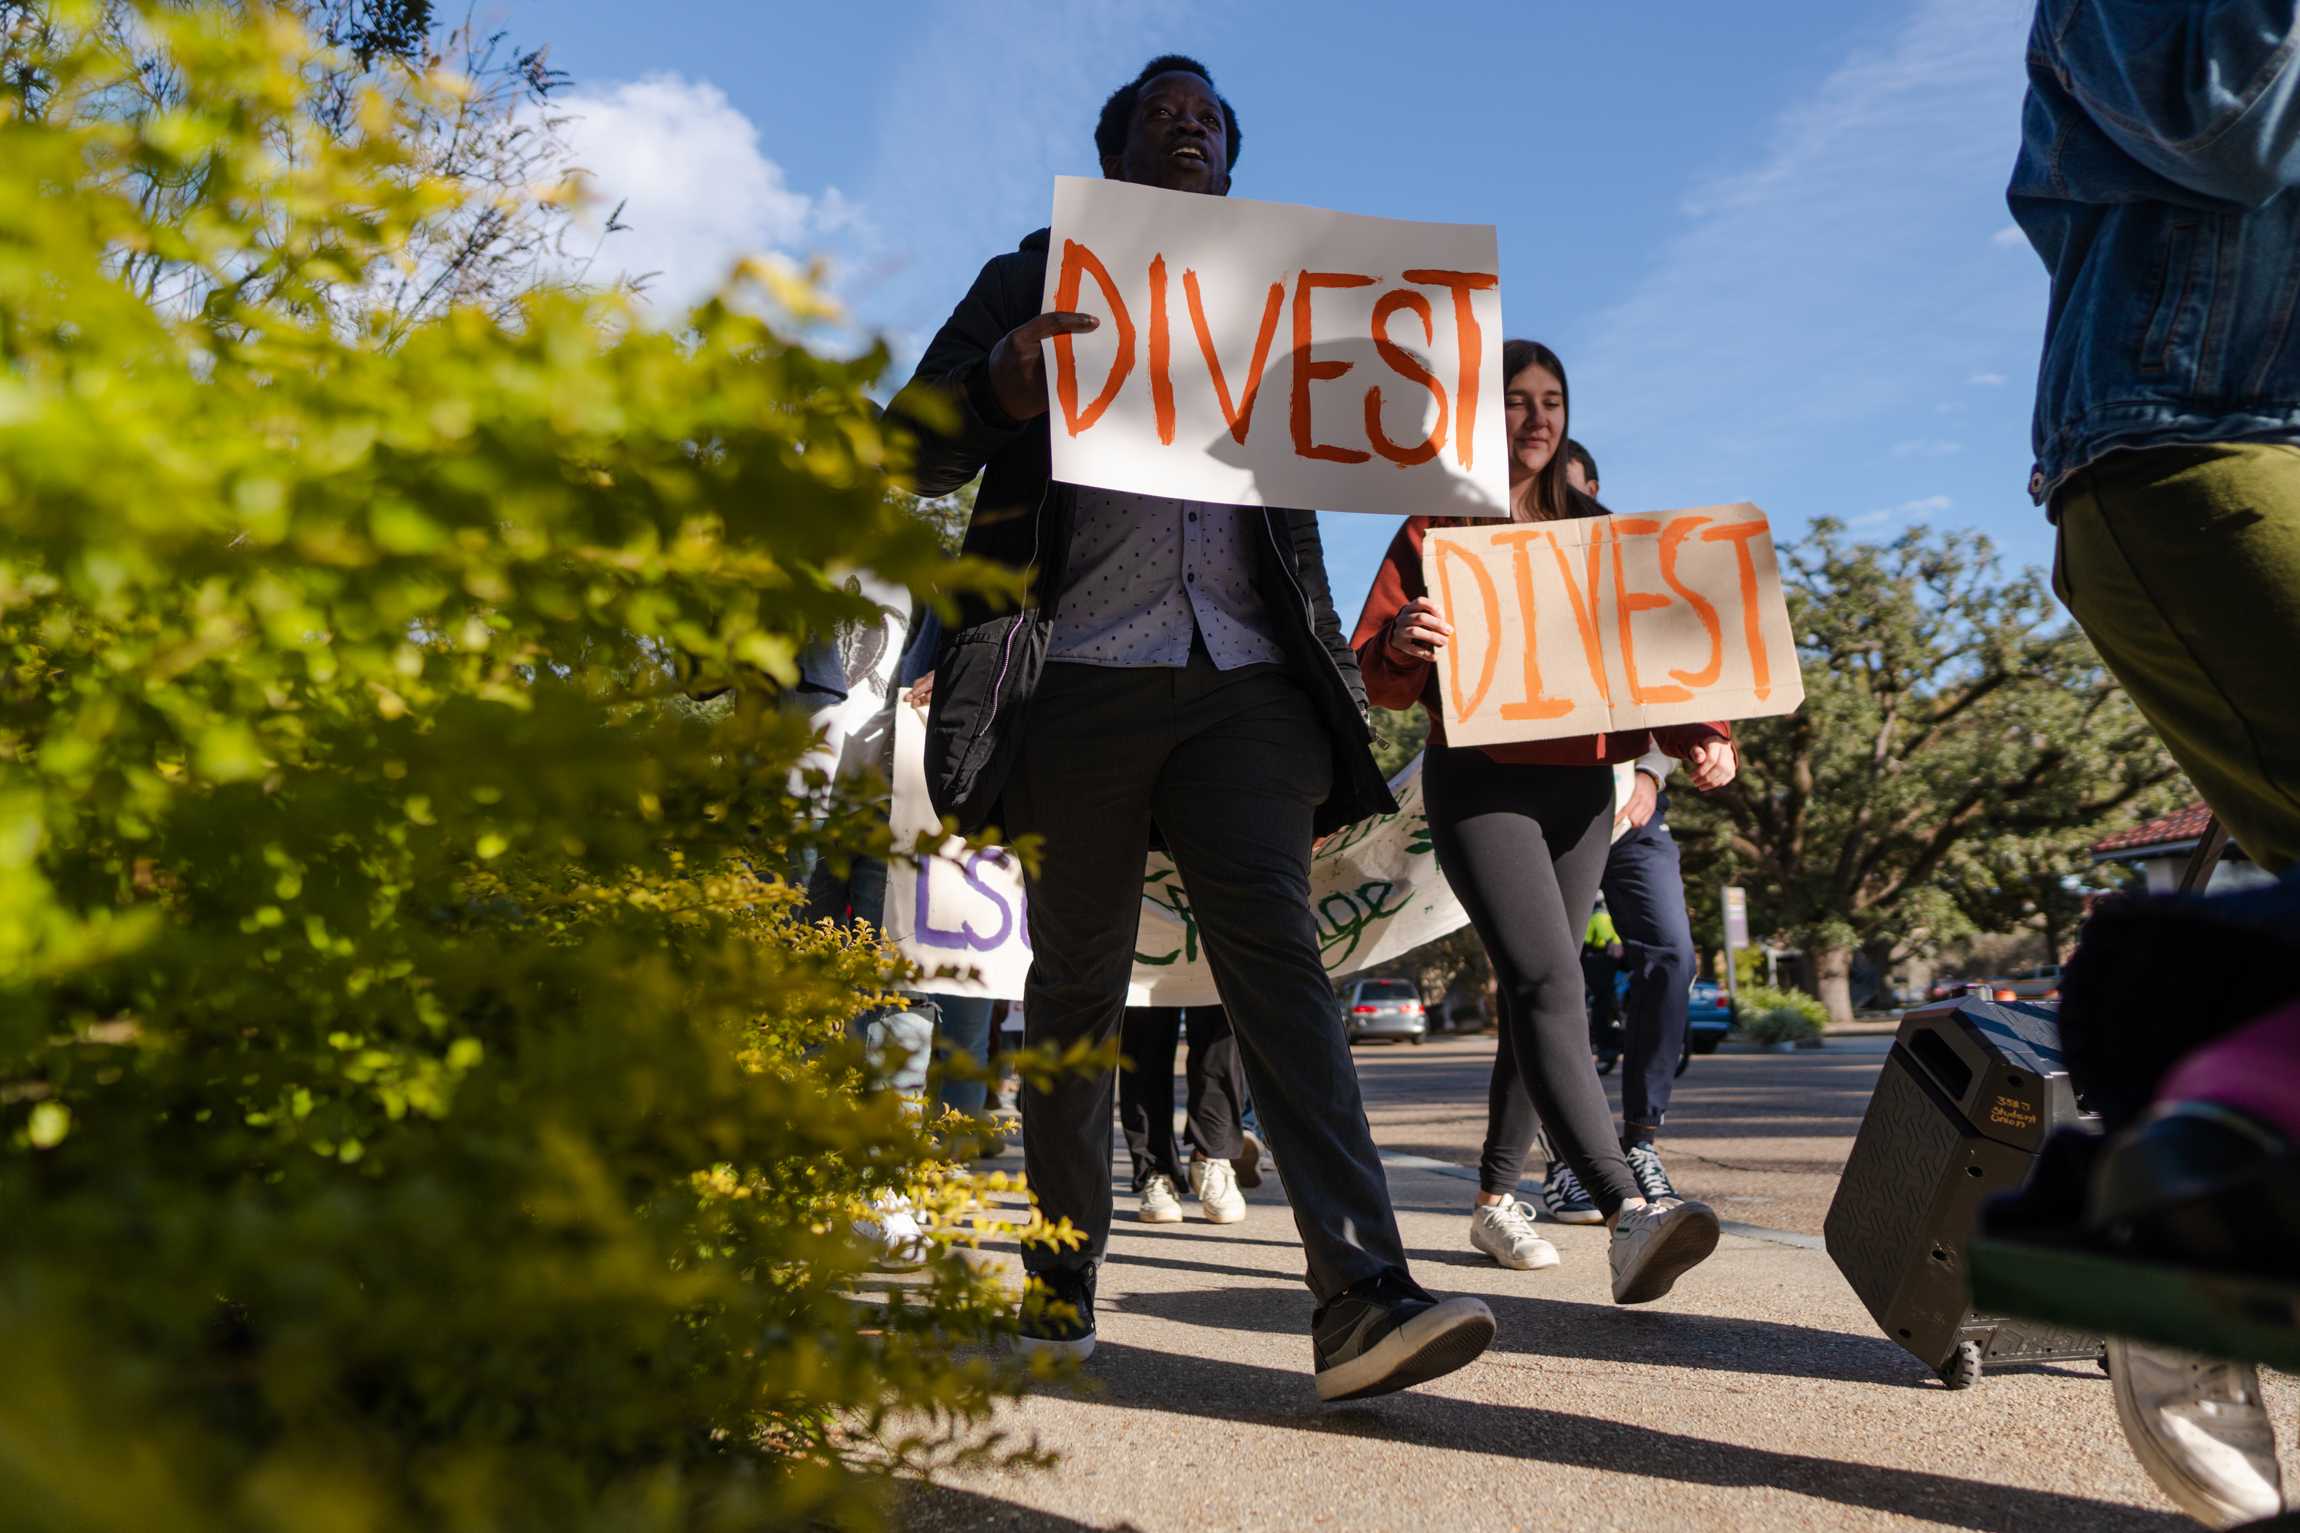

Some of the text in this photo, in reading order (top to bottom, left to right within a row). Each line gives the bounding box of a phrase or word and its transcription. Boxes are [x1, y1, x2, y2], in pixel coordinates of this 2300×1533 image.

[1052, 238, 1498, 473] DIVEST
[1434, 516, 1771, 724] DIVEST
[914, 847, 1032, 951] LS
